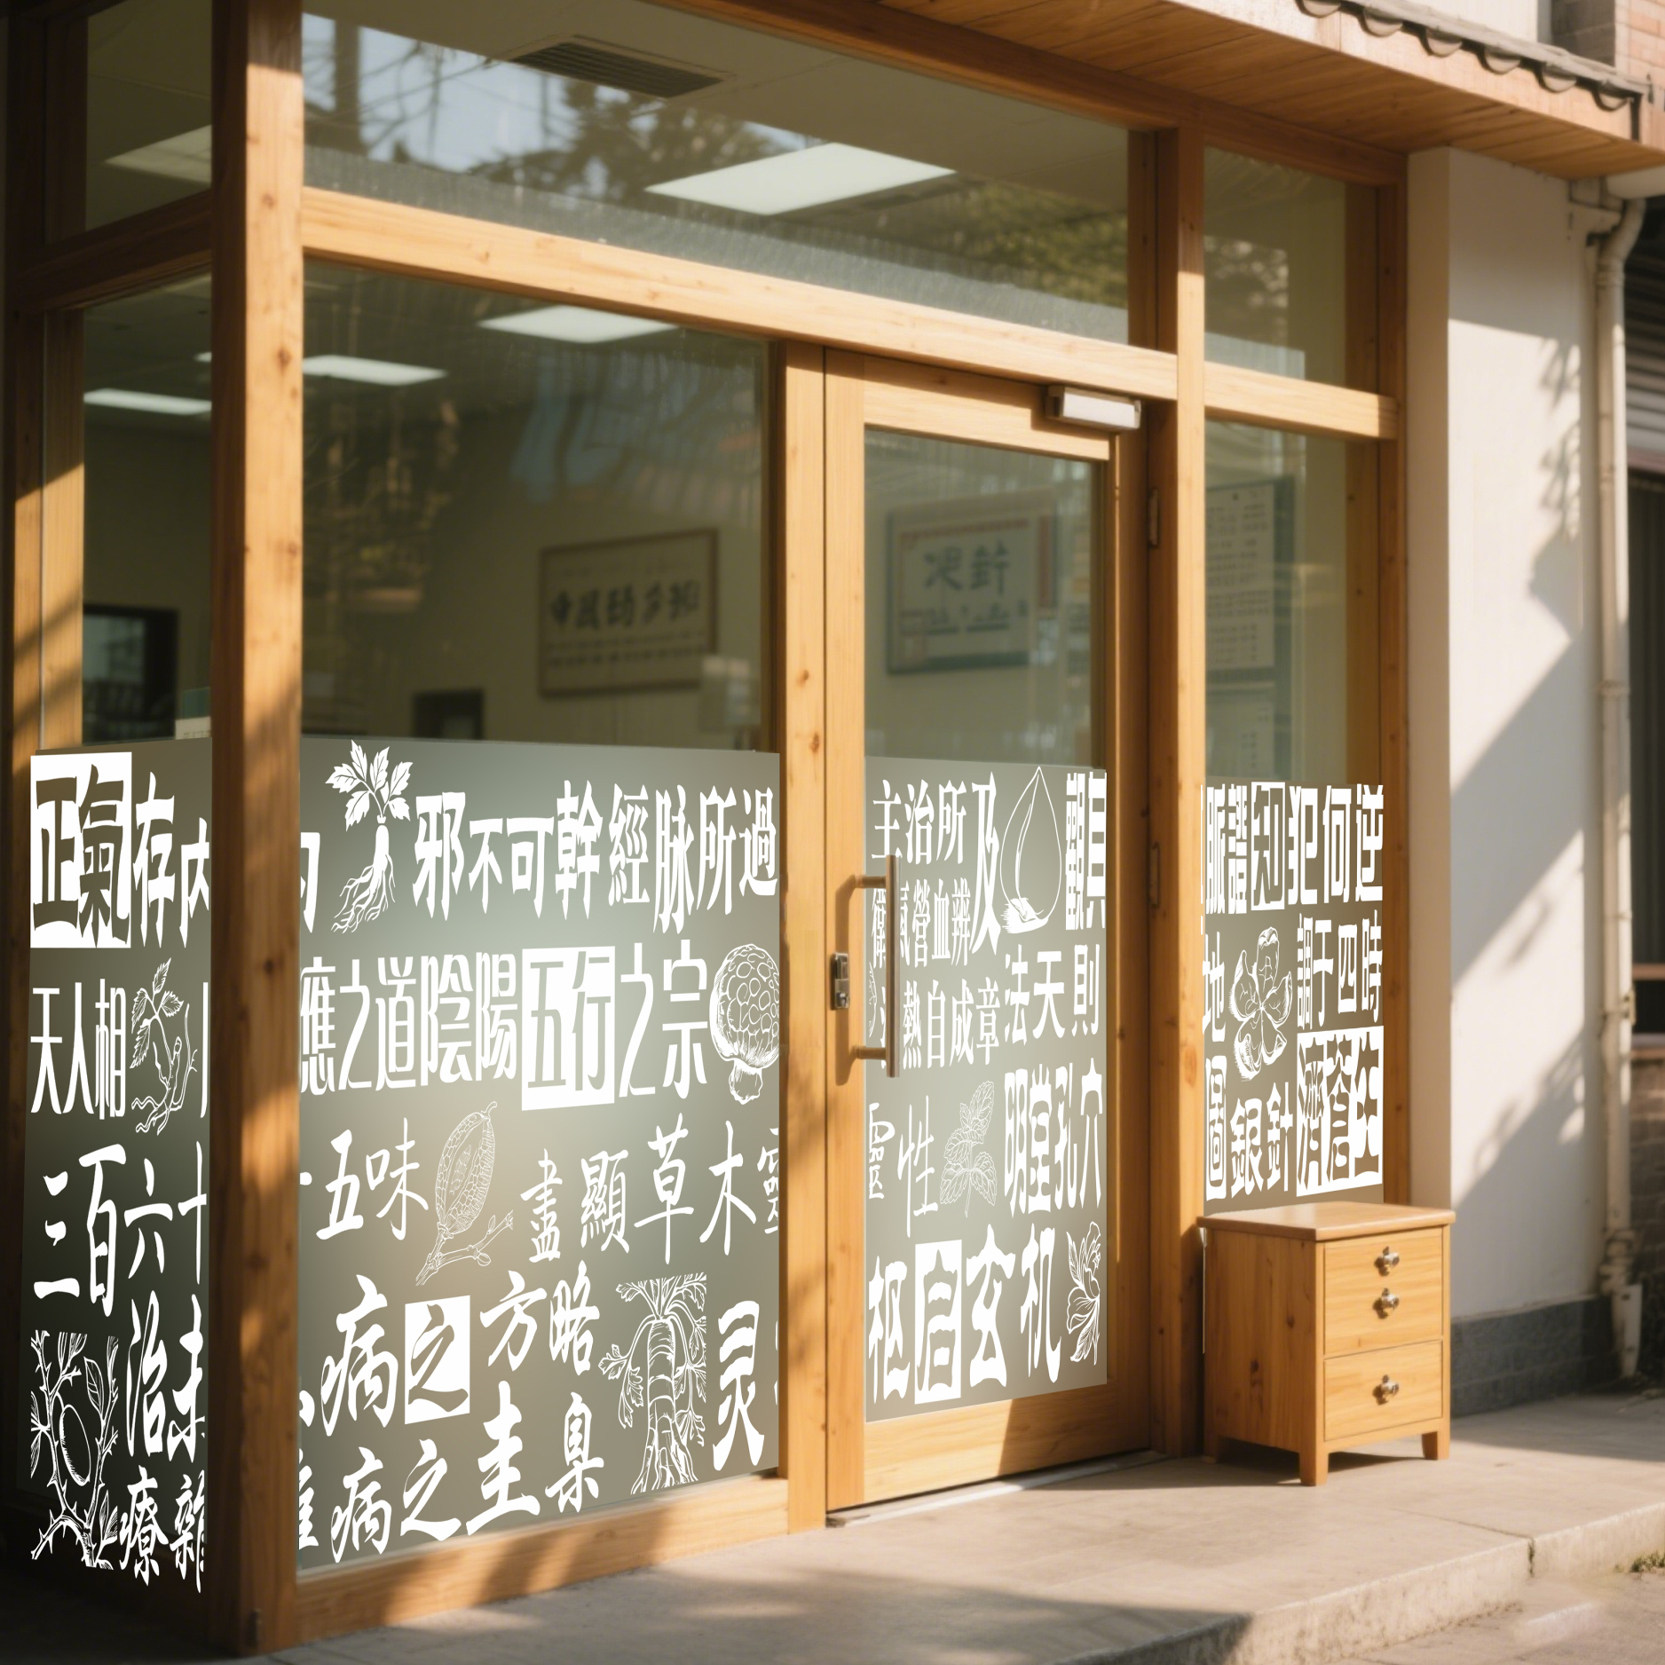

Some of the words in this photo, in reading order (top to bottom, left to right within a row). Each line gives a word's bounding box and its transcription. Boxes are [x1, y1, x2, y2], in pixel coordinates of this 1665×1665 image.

[872, 773, 1001, 955] 主治所及
[31, 979, 125, 1119] 天人相
[301, 940, 707, 1096] 應之道陰陽五行之宗
[880, 977, 1000, 1069] 熱自成章
[1005, 945, 1099, 1045] 法天則
[317, 1118, 428, 1240] 五味
[321, 1260, 599, 1436] 病之方略
